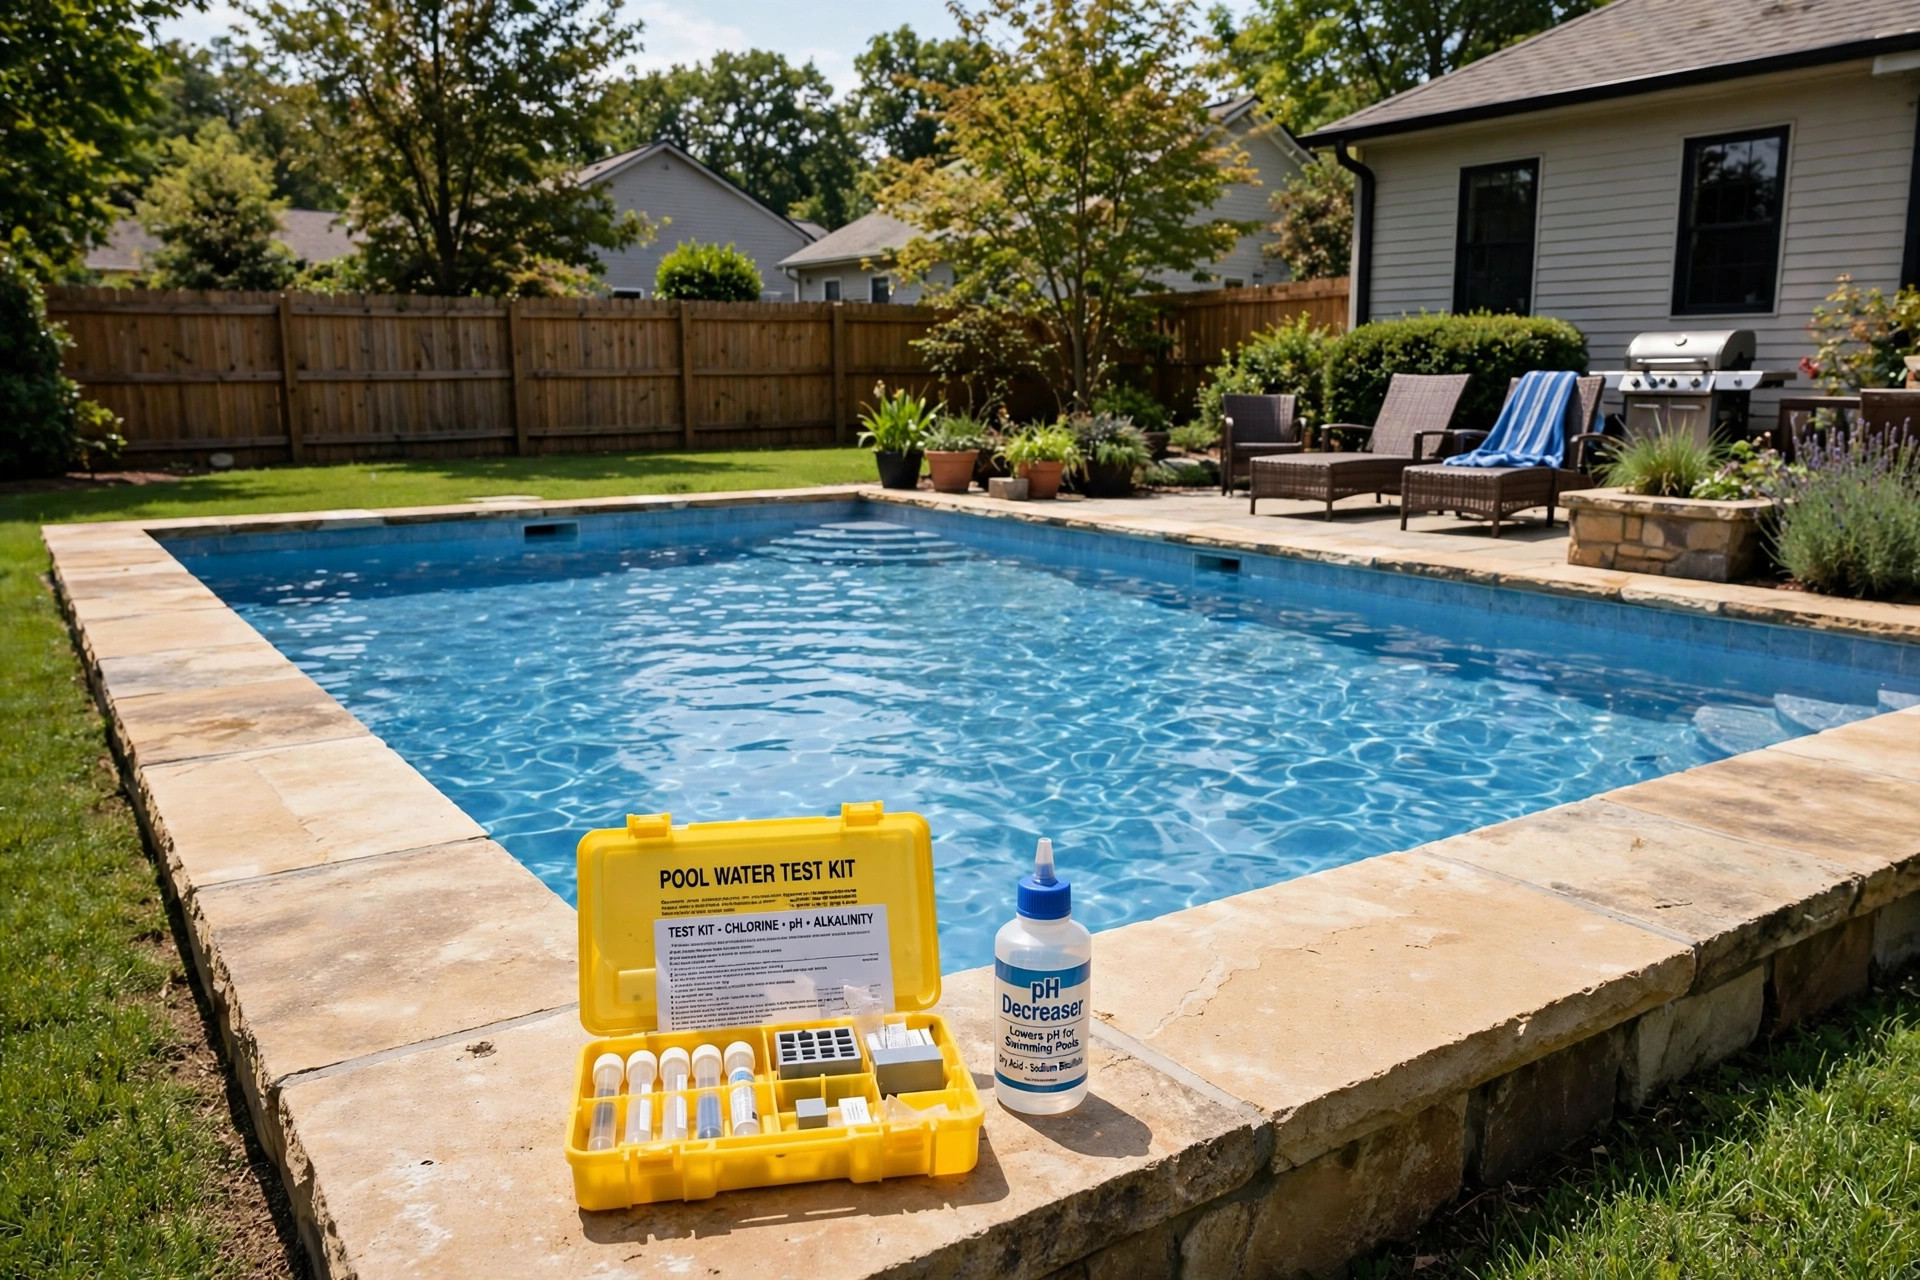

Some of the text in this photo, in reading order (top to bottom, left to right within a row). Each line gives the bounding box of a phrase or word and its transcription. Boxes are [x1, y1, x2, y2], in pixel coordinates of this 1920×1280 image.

[660, 859, 856, 888] POOL WATER TEST KIT
[668, 926, 696, 938] TEST
[698, 924, 714, 936] KIT
[724, 919, 779, 934] CHLORINE
[789, 918, 802, 932] pH
[814, 913, 873, 928] ALKALINITY
[1031, 978, 1060, 1004] pH
[1002, 993, 1084, 1022] Decreaser
[1005, 1036, 1052, 1054] Swimming
[1009, 1026, 1074, 1043] Lowers pH for
[1008, 1058, 1024, 1070] Acid
